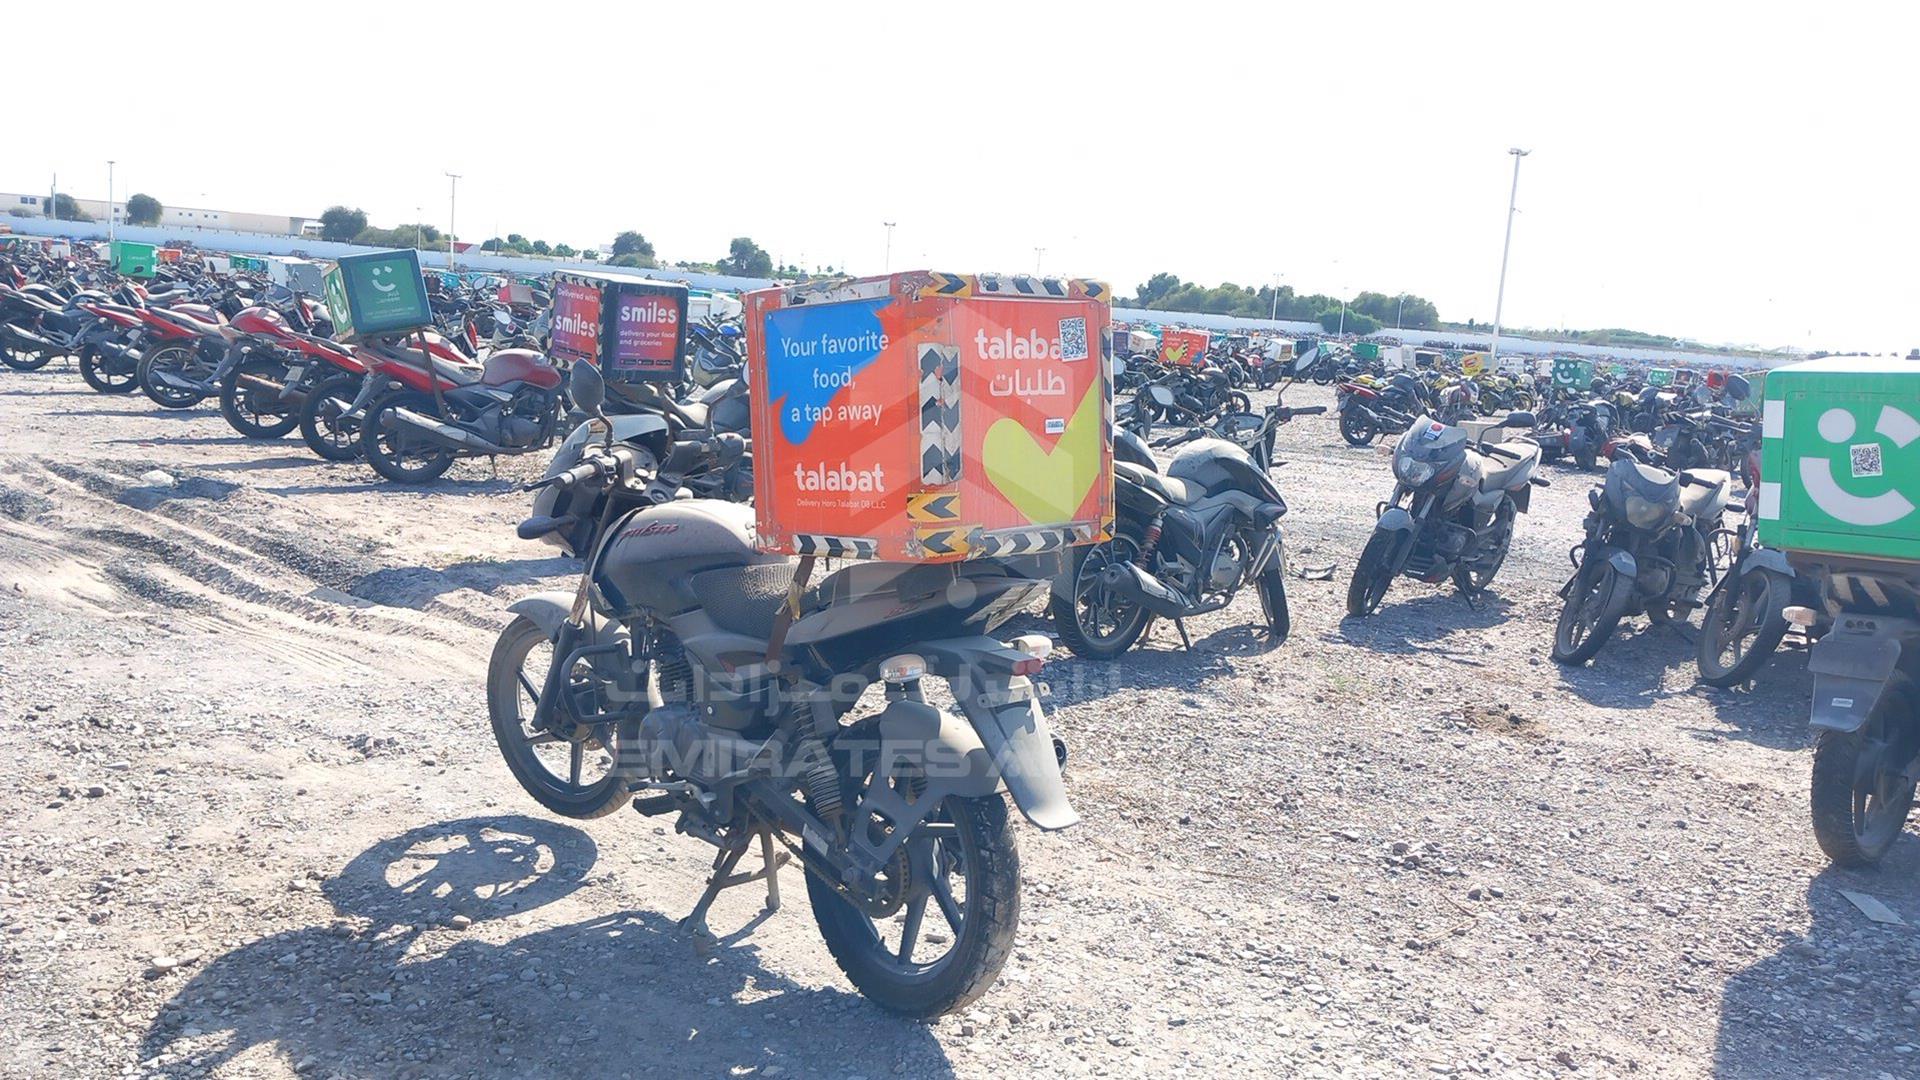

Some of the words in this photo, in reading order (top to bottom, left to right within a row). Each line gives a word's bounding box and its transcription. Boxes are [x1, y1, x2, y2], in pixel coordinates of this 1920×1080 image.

[555, 313, 595, 338] smiles
[621, 302, 676, 324] smiles
[661, 330, 675, 338] food
[781, 337, 817, 358] Your
[821, 330, 889, 355] favorite
[974, 327, 1062, 360] talaba
[812, 366, 856, 390] food,
[989, 369, 1066, 405] طلبات
[791, 408, 800, 422] a
[805, 403, 833, 427] tap
[838, 404, 882, 426] away
[794, 461, 885, 492] talabat
